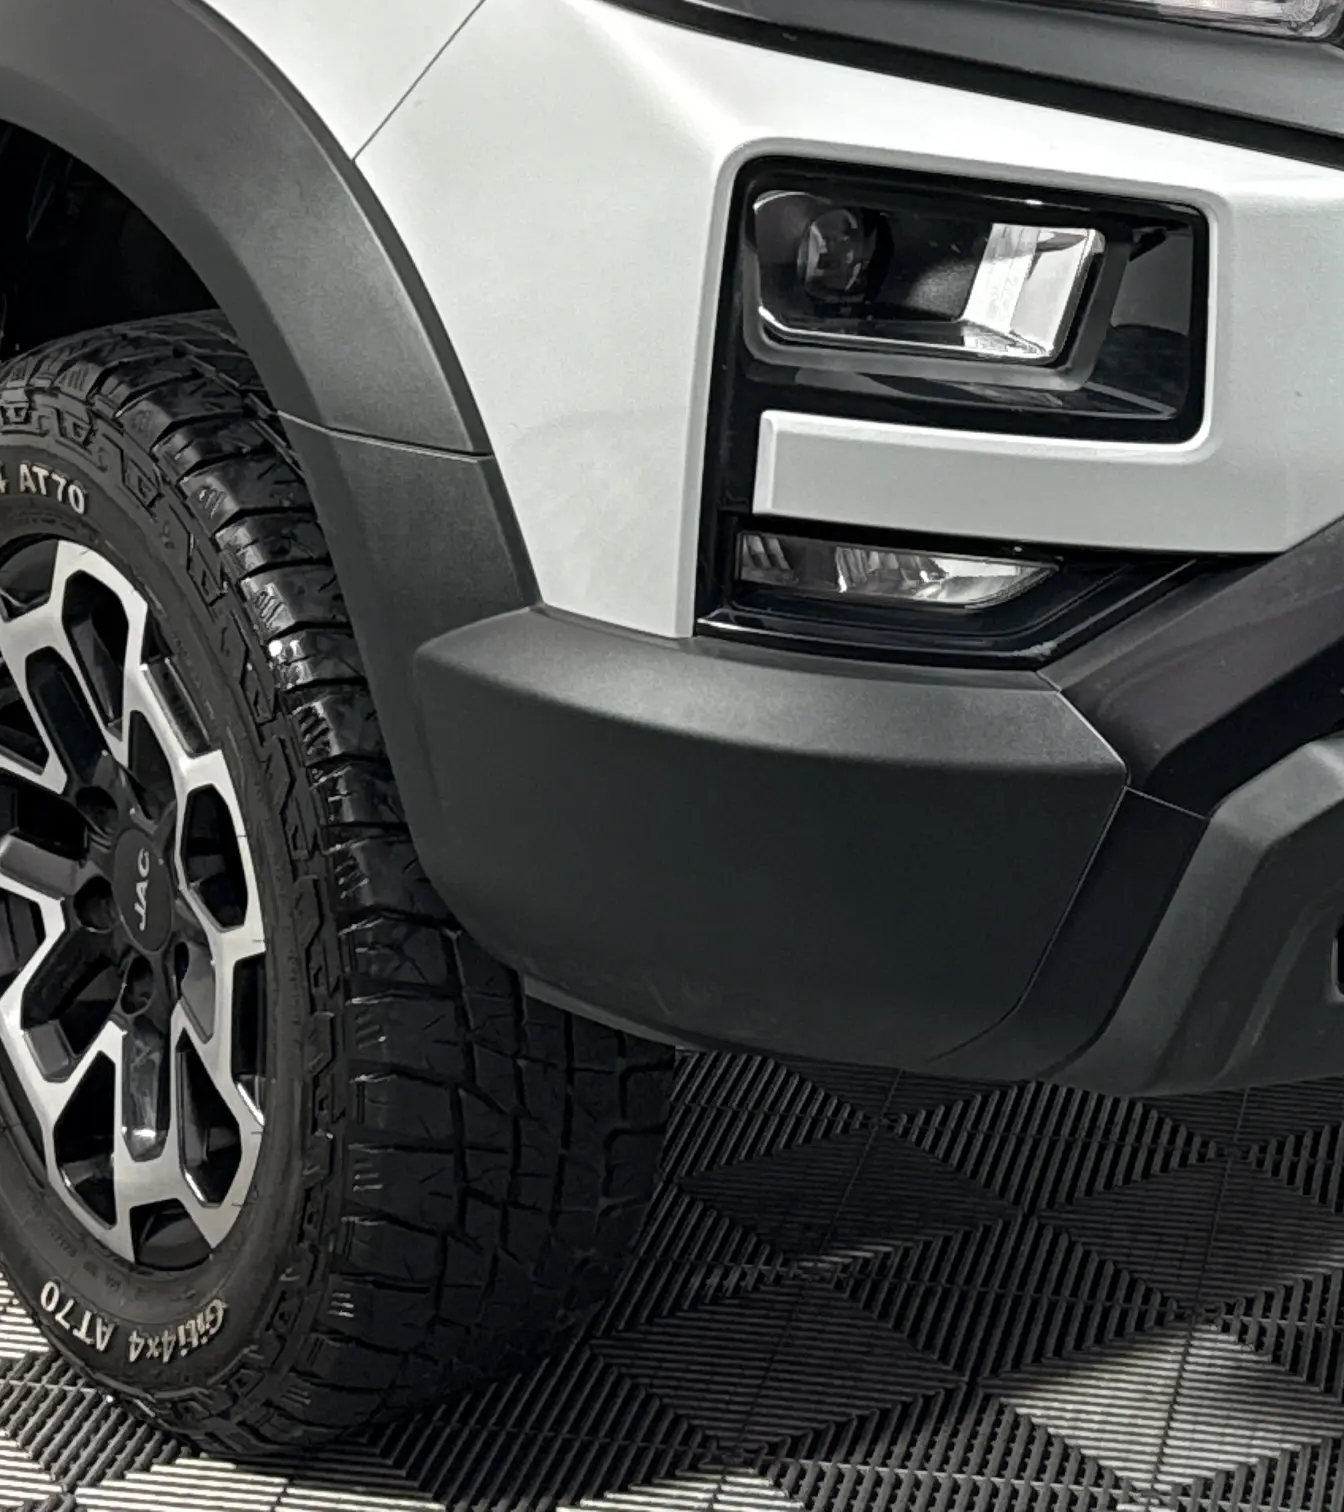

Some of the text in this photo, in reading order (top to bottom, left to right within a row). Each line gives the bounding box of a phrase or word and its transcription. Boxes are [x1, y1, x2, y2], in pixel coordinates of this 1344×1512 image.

[19, 462, 86, 515] AT70
[134, 848, 150, 931] JAC
[40, 1280, 226, 1363] Giti4x4 AT70
